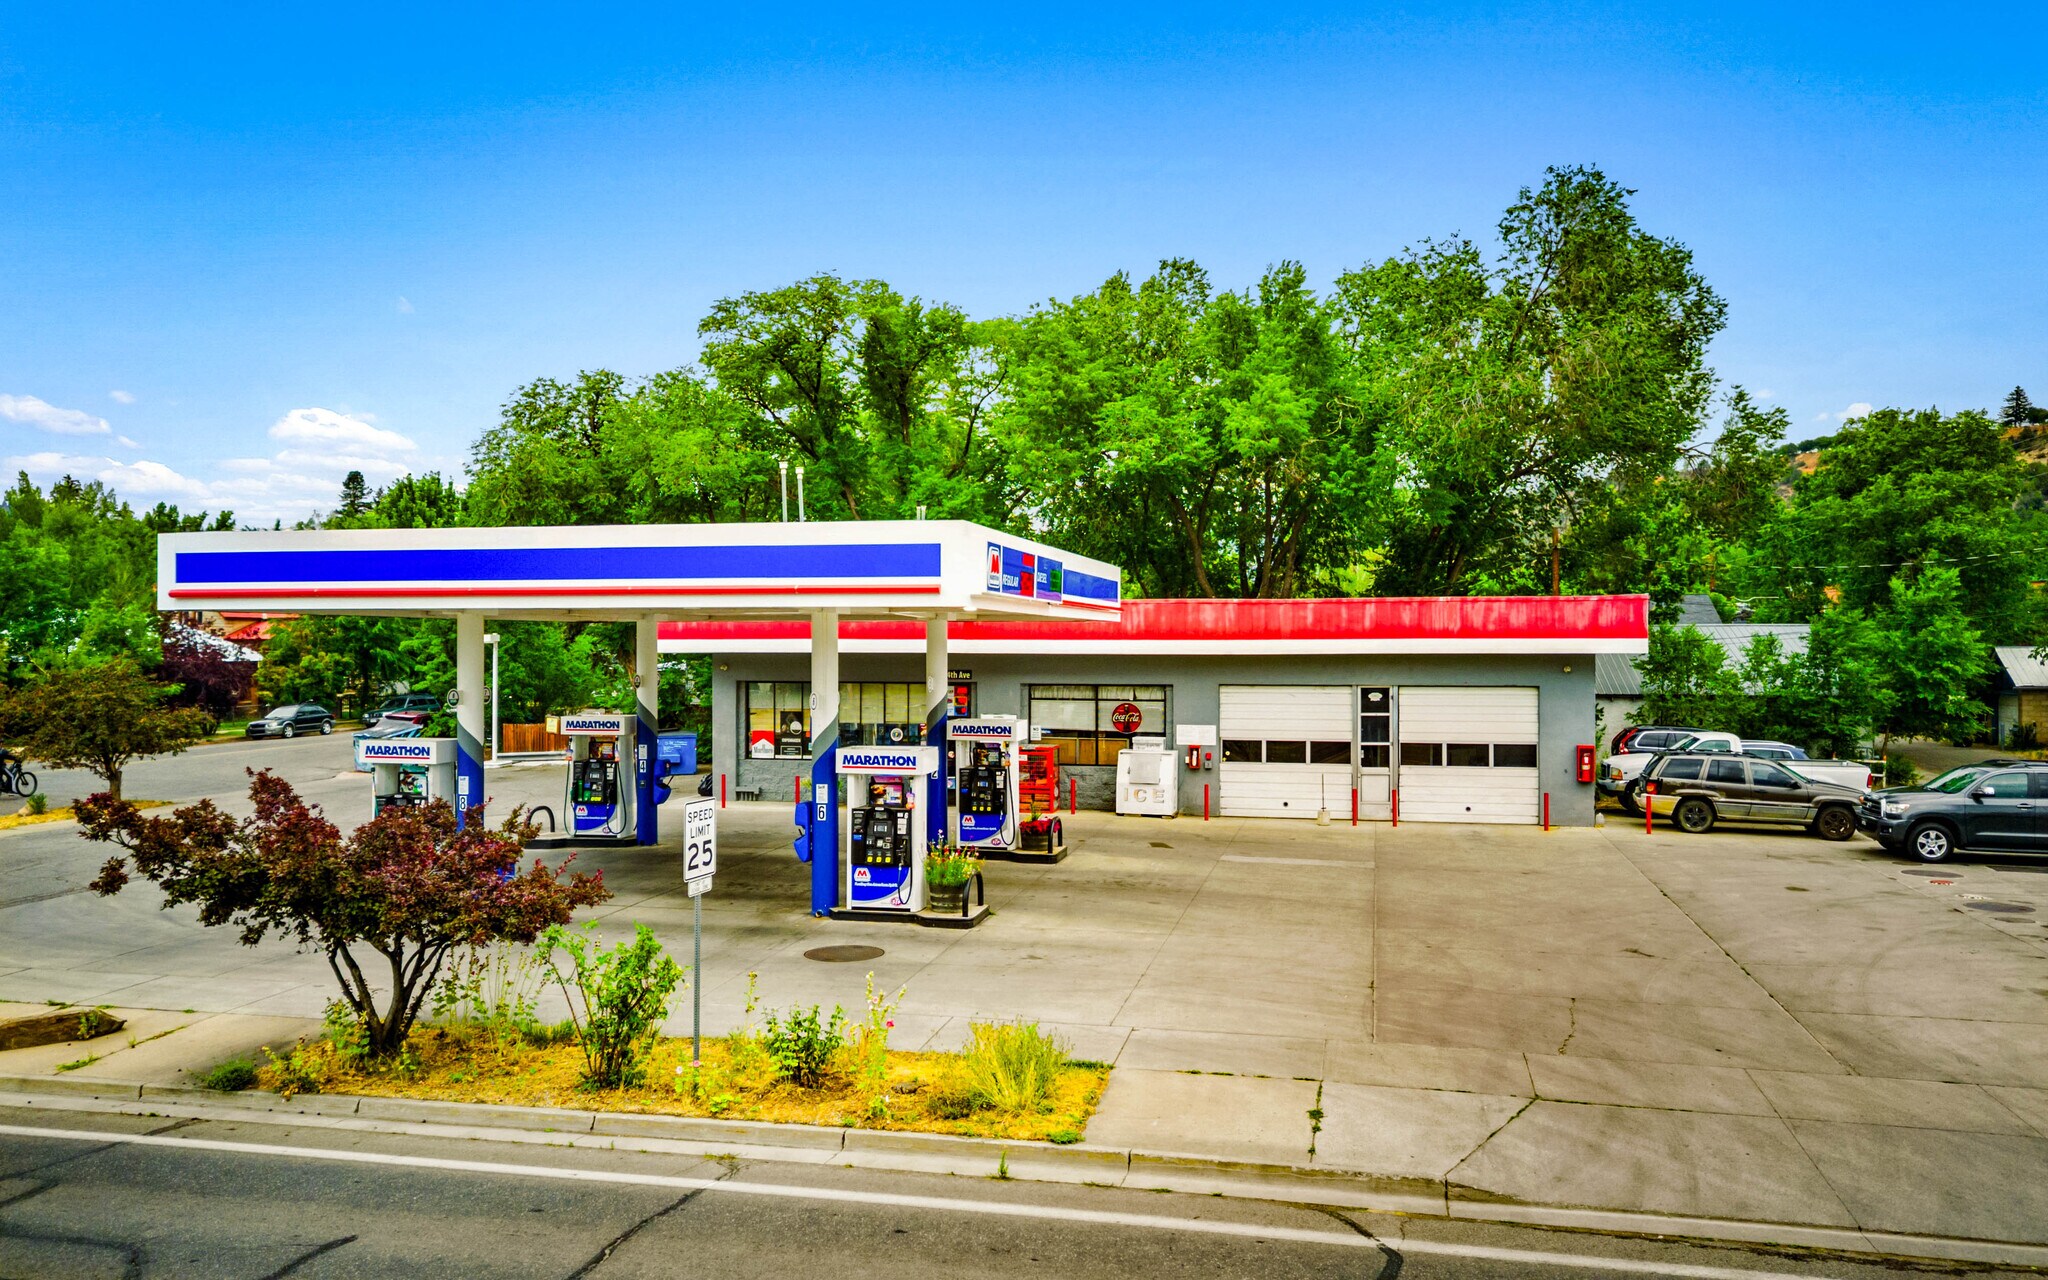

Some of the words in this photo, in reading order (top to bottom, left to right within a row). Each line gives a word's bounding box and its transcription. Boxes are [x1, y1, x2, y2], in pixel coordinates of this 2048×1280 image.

[1003, 574, 1019, 587] REGULAR
[1037, 572, 1047, 584] DIESEL
[959, 671, 970, 679] Ave
[566, 720, 620, 729] MARATHON
[952, 725, 1012, 735] MARATHON
[365, 745, 430, 756] MARATHON
[640, 760, 645, 772] 4
[842, 754, 917, 767] MARATHON
[1123, 787, 1165, 804] ICE
[460, 796, 467, 811] 8
[687, 808, 714, 823] SPEED
[818, 805, 825, 819] 6
[690, 824, 711, 839] LIMIT
[687, 839, 713, 871] 25
